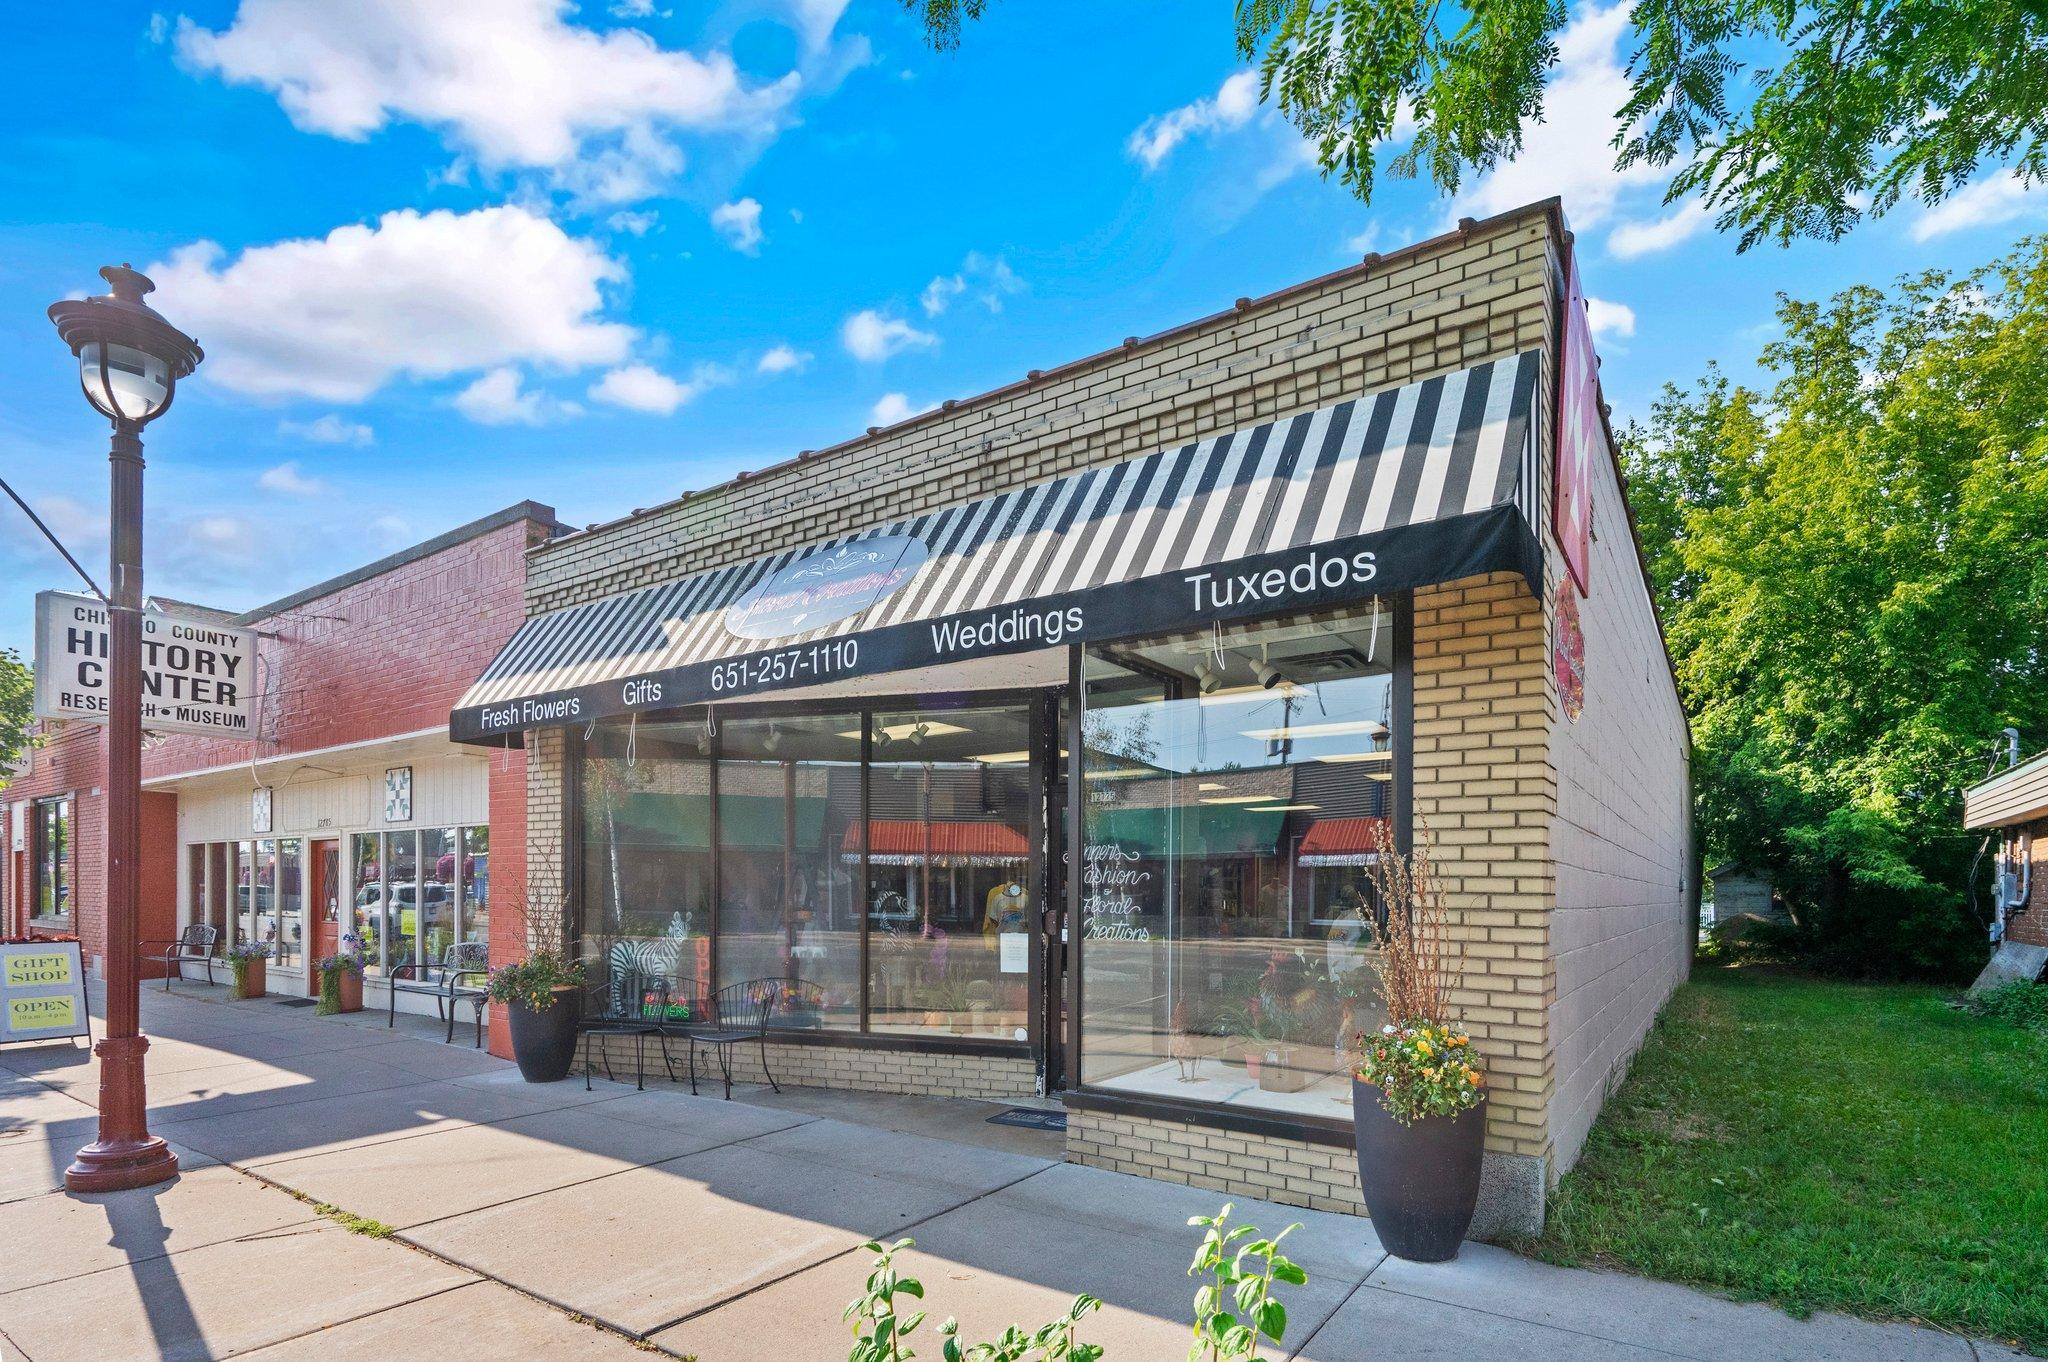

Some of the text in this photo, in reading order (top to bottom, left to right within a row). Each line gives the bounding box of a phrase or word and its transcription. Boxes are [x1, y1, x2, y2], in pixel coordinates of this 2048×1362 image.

[1184, 551, 1377, 612] Tuxedos
[74, 606, 239, 648] CHIO COUNTY
[931, 606, 1084, 654] Weddings
[67, 627, 242, 679] HITORY
[710, 640, 859, 692] 651-257-1110
[77, 661, 237, 707] CNTER
[622, 679, 662, 705] Gifts
[61, 692, 246, 729] RESEH MUSEUM
[481, 697, 580, 730] Fresh Flowers
[1084, 863, 1150, 885] ashion
[11, 970, 68, 982] SHOP
[13, 957, 64, 969] GIFT
[14, 1000, 70, 1013] OPEN
